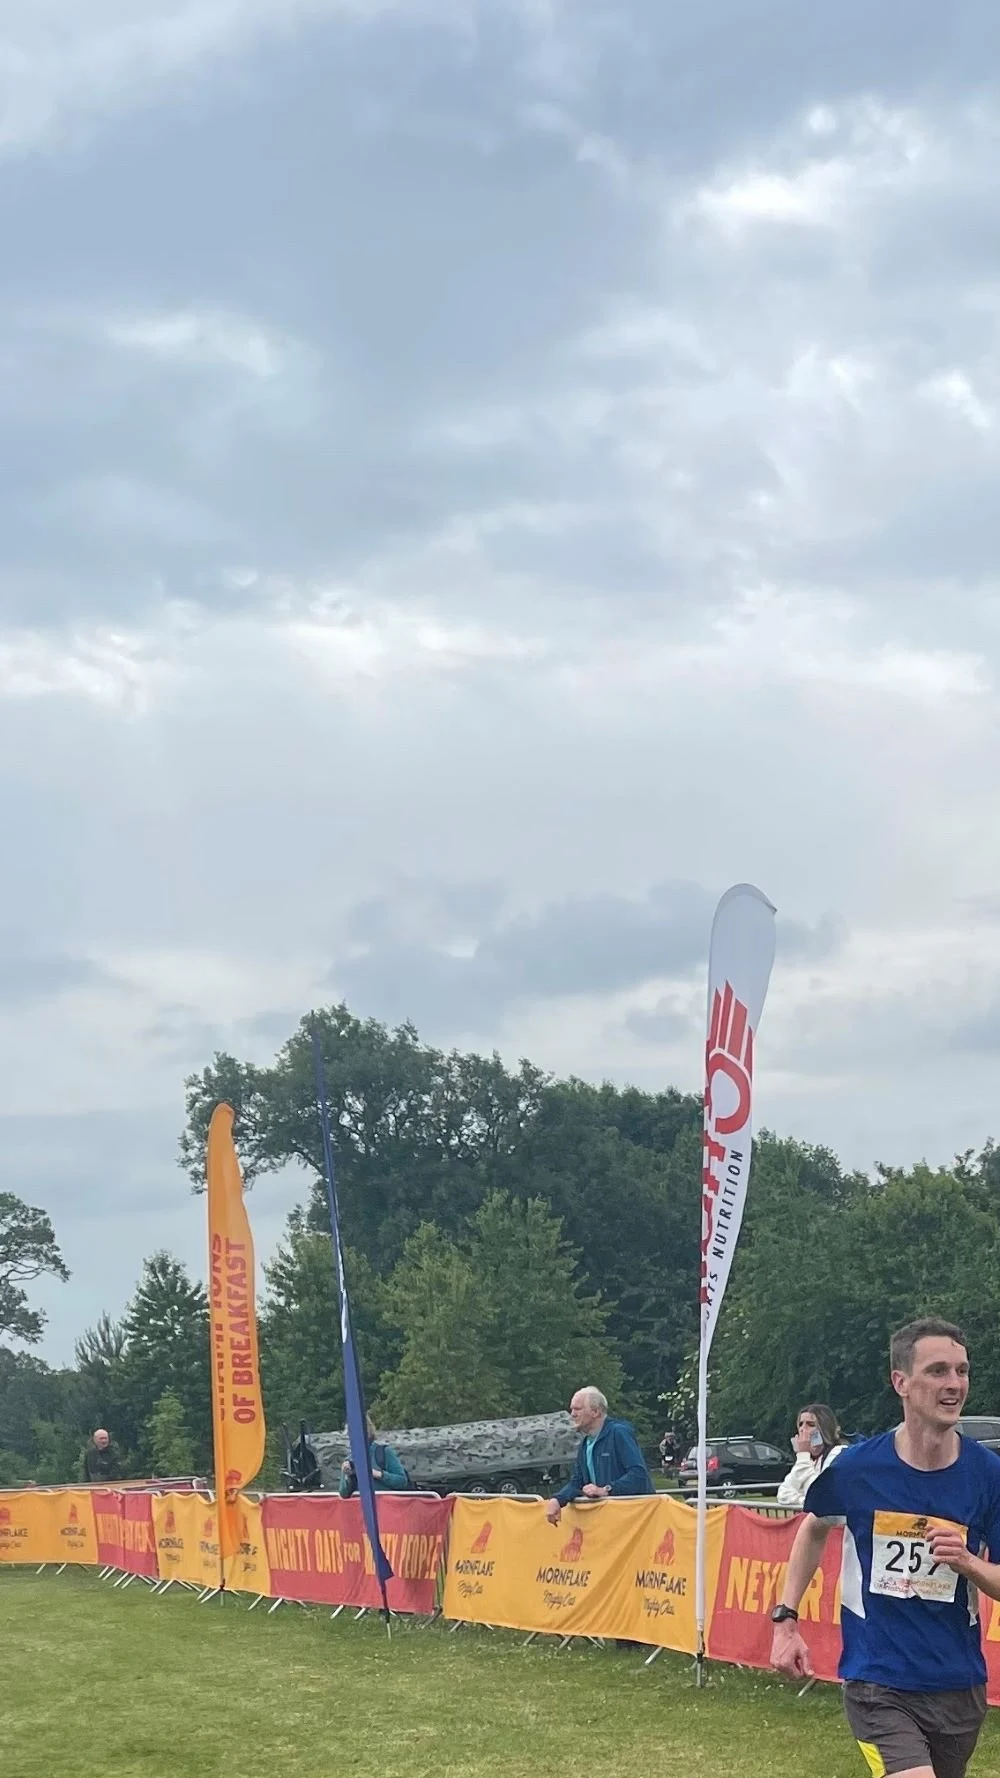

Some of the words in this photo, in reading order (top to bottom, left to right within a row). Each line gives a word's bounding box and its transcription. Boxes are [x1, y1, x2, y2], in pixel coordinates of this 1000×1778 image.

[712, 1149, 743, 1260] NUTRITION
[225, 1238, 254, 1386] BREAKFAST
[232, 1396, 255, 1424] OF
[266, 1528, 311, 1571] MIGHTY
[315, 1529, 344, 1574] OATS
[343, 1542, 361, 1563] FOR
[363, 1533, 398, 1577] MTY
[399, 1534, 442, 1579] PEOPLE
[536, 1567, 591, 1587] MORNFLAKE
[635, 1570, 686, 1596] MORNFLAKE
